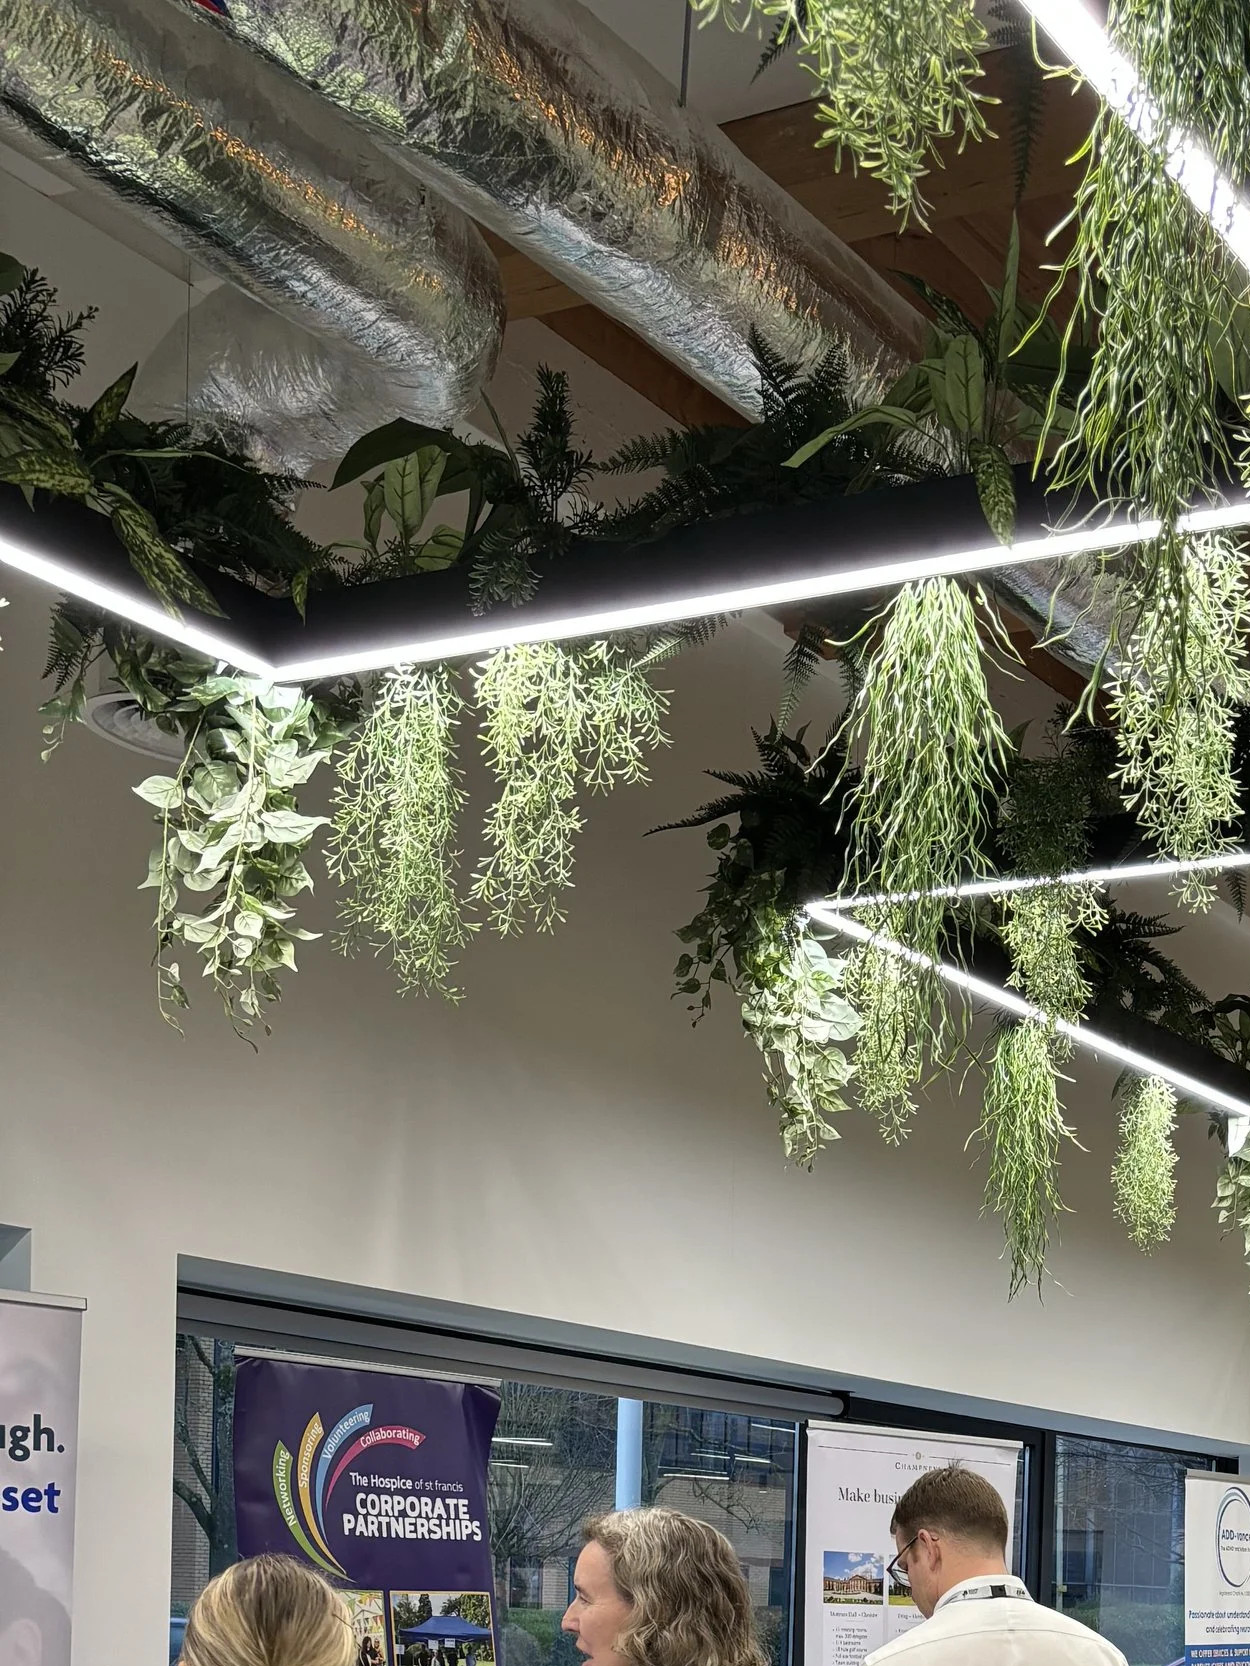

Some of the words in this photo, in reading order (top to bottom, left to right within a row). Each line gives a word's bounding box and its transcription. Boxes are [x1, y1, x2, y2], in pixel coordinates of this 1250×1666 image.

[322, 1411, 370, 1460] Volunteering
[360, 1428, 421, 1448] Collaborating
[299, 1423, 323, 1489] Sponsoring
[275, 1449, 297, 1527] Networking
[349, 1472, 368, 1487] The
[370, 1474, 413, 1491] Hospice
[414, 1479, 424, 1490] of
[425, 1480, 434, 1491] st
[435, 1480, 464, 1492] francis
[838, 1486, 871, 1503] Make
[2, 1482, 61, 1514] set
[355, 1492, 470, 1520] CORPORATE
[342, 1513, 482, 1541] PARTNERSHIPS
